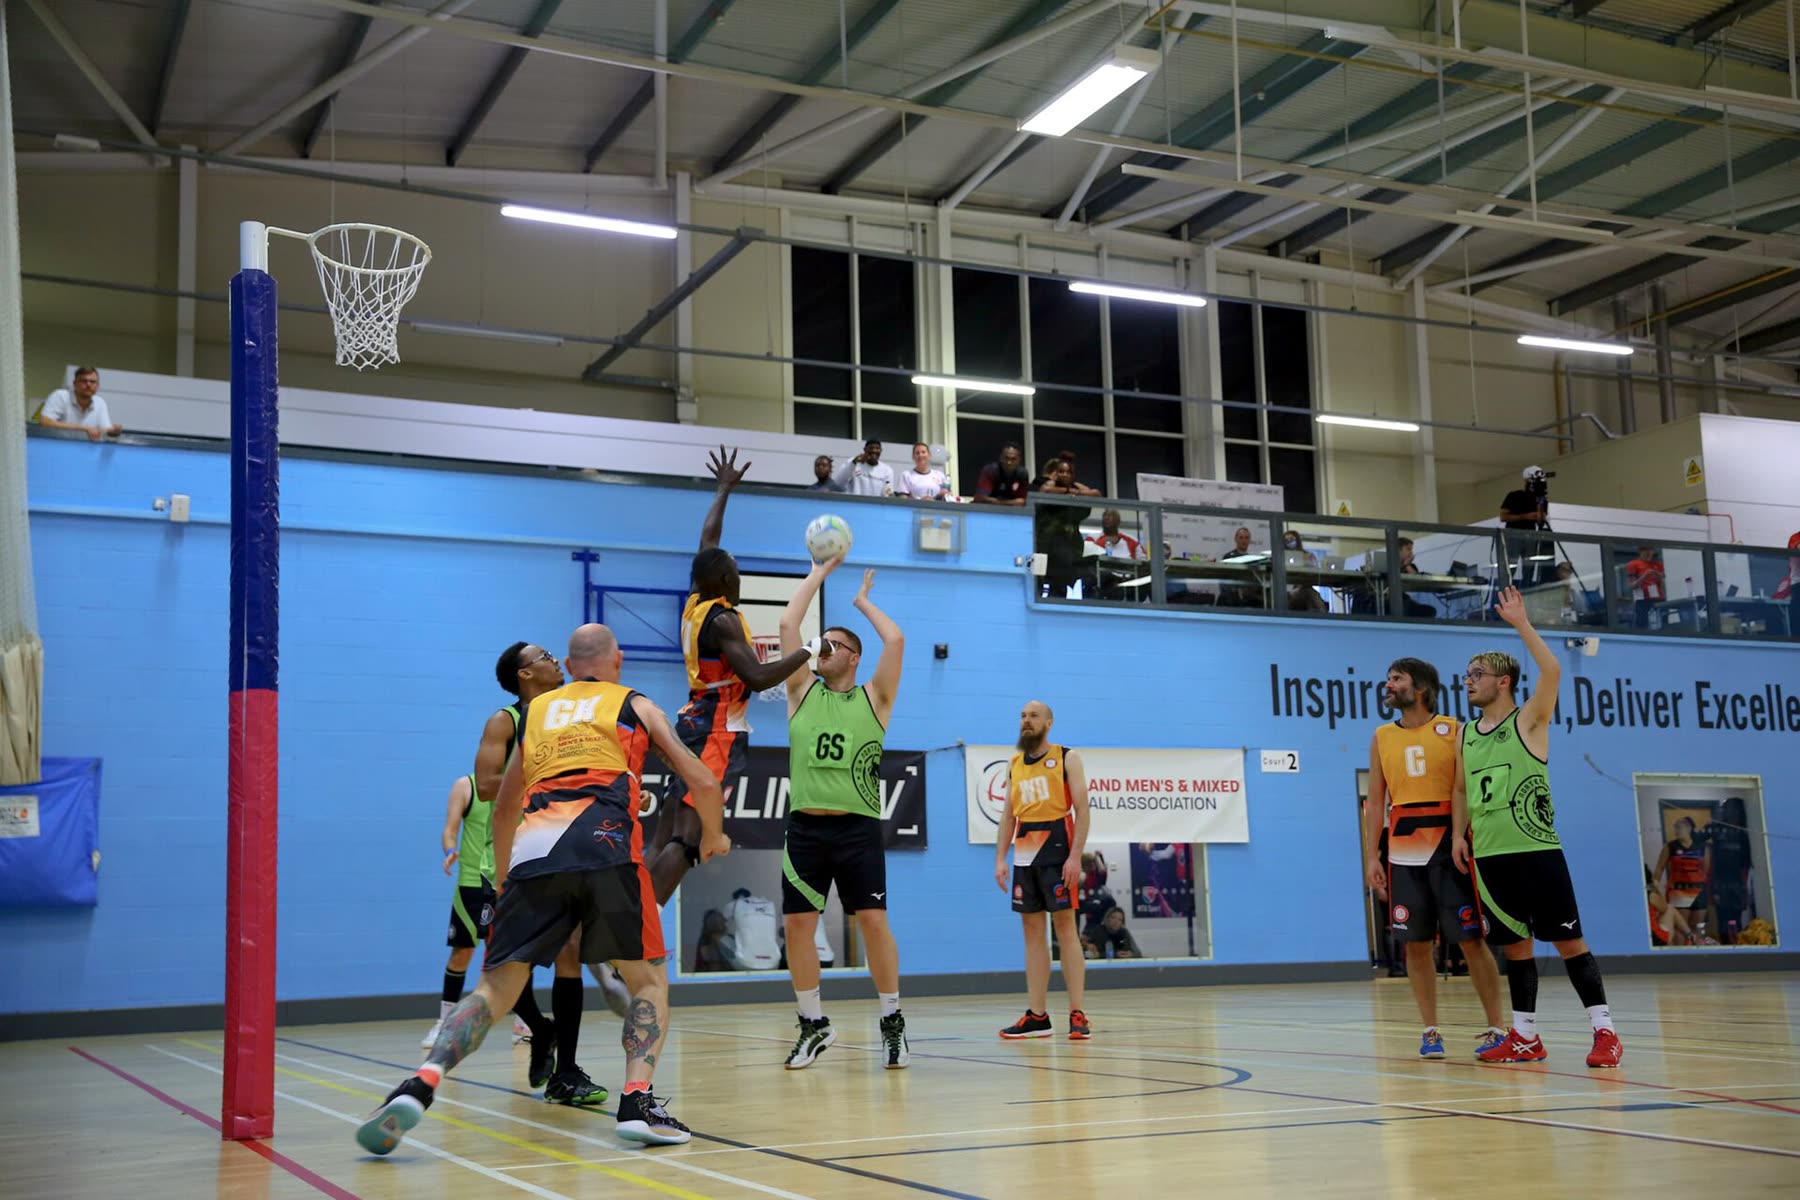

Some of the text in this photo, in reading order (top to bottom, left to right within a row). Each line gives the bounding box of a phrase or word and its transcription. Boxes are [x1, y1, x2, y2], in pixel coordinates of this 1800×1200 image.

[1270, 663, 1394, 730] Inspire
[1695, 681, 1800, 732] Excelle
[544, 695, 603, 730] GK
[816, 732, 845, 761] GS
[1287, 753, 1298, 770] 2
[1405, 745, 1426, 777] C
[1088, 779, 1240, 793] AND MEN'S & MIXED
[1481, 776, 1493, 803] C
[1088, 797, 1217, 810] ALL ASSOCIATION
